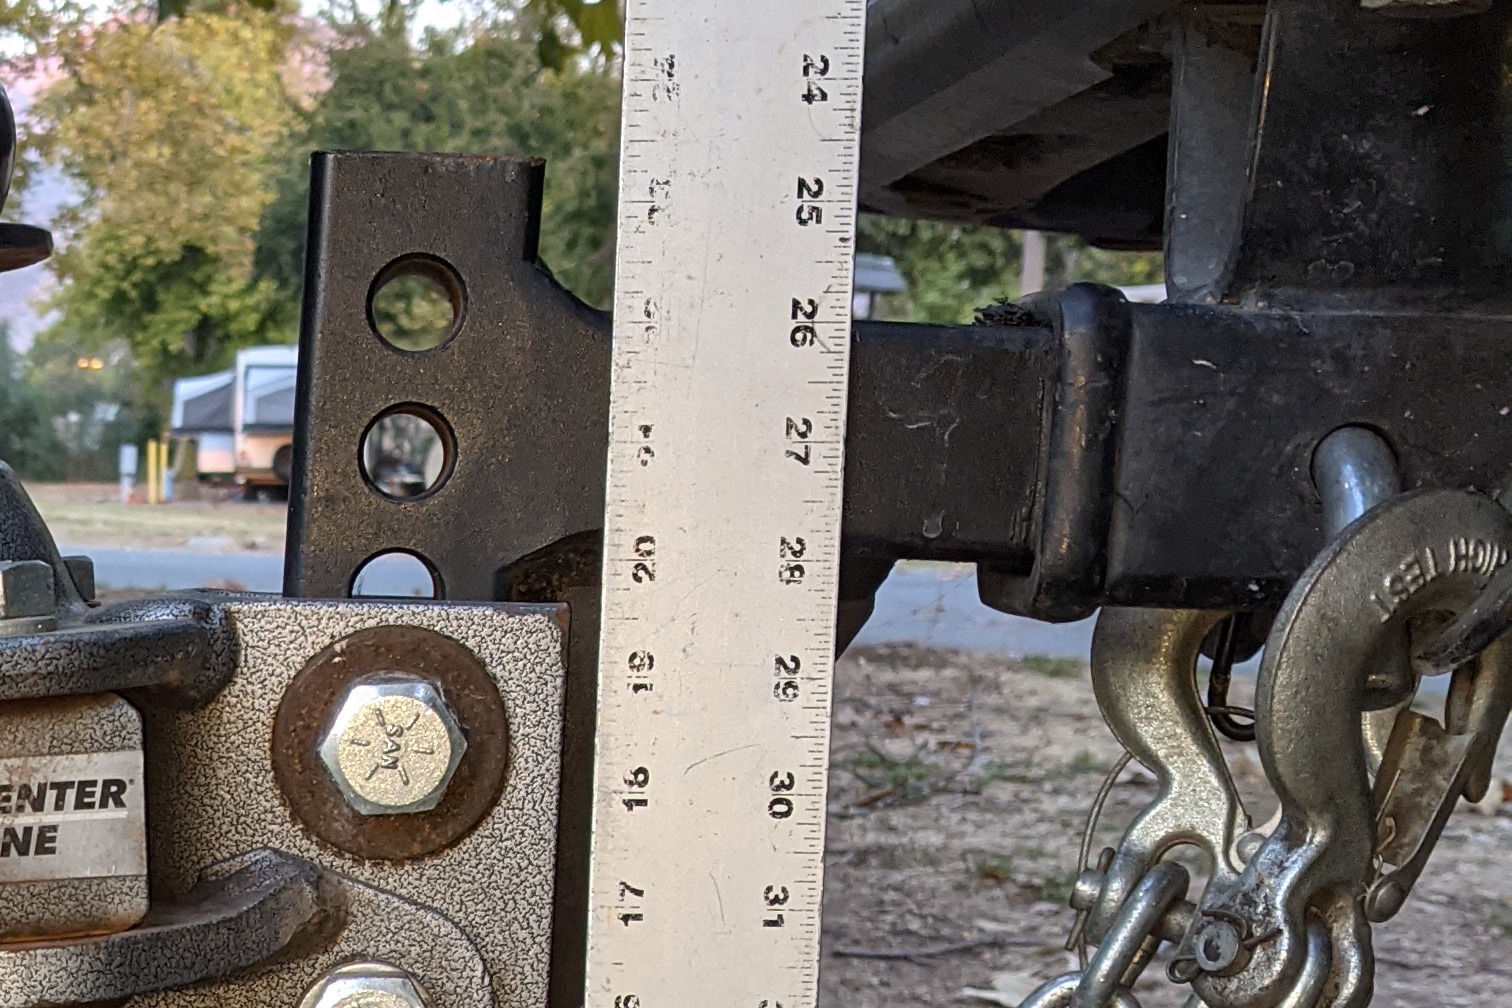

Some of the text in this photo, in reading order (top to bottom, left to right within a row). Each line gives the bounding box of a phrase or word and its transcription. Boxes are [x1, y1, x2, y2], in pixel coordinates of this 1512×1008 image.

[801, 55, 829, 104] 24
[796, 177, 823, 225] 25
[790, 299, 818, 346] 26
[786, 418, 812, 465] 27
[632, 536, 656, 584] 20
[779, 537, 805, 584] 28
[774, 655, 800, 701] 29
[622, 766, 649, 811] 18
[768, 771, 794, 818] 30
[617, 882, 644, 927] 17
[763, 885, 789, 928] 31
